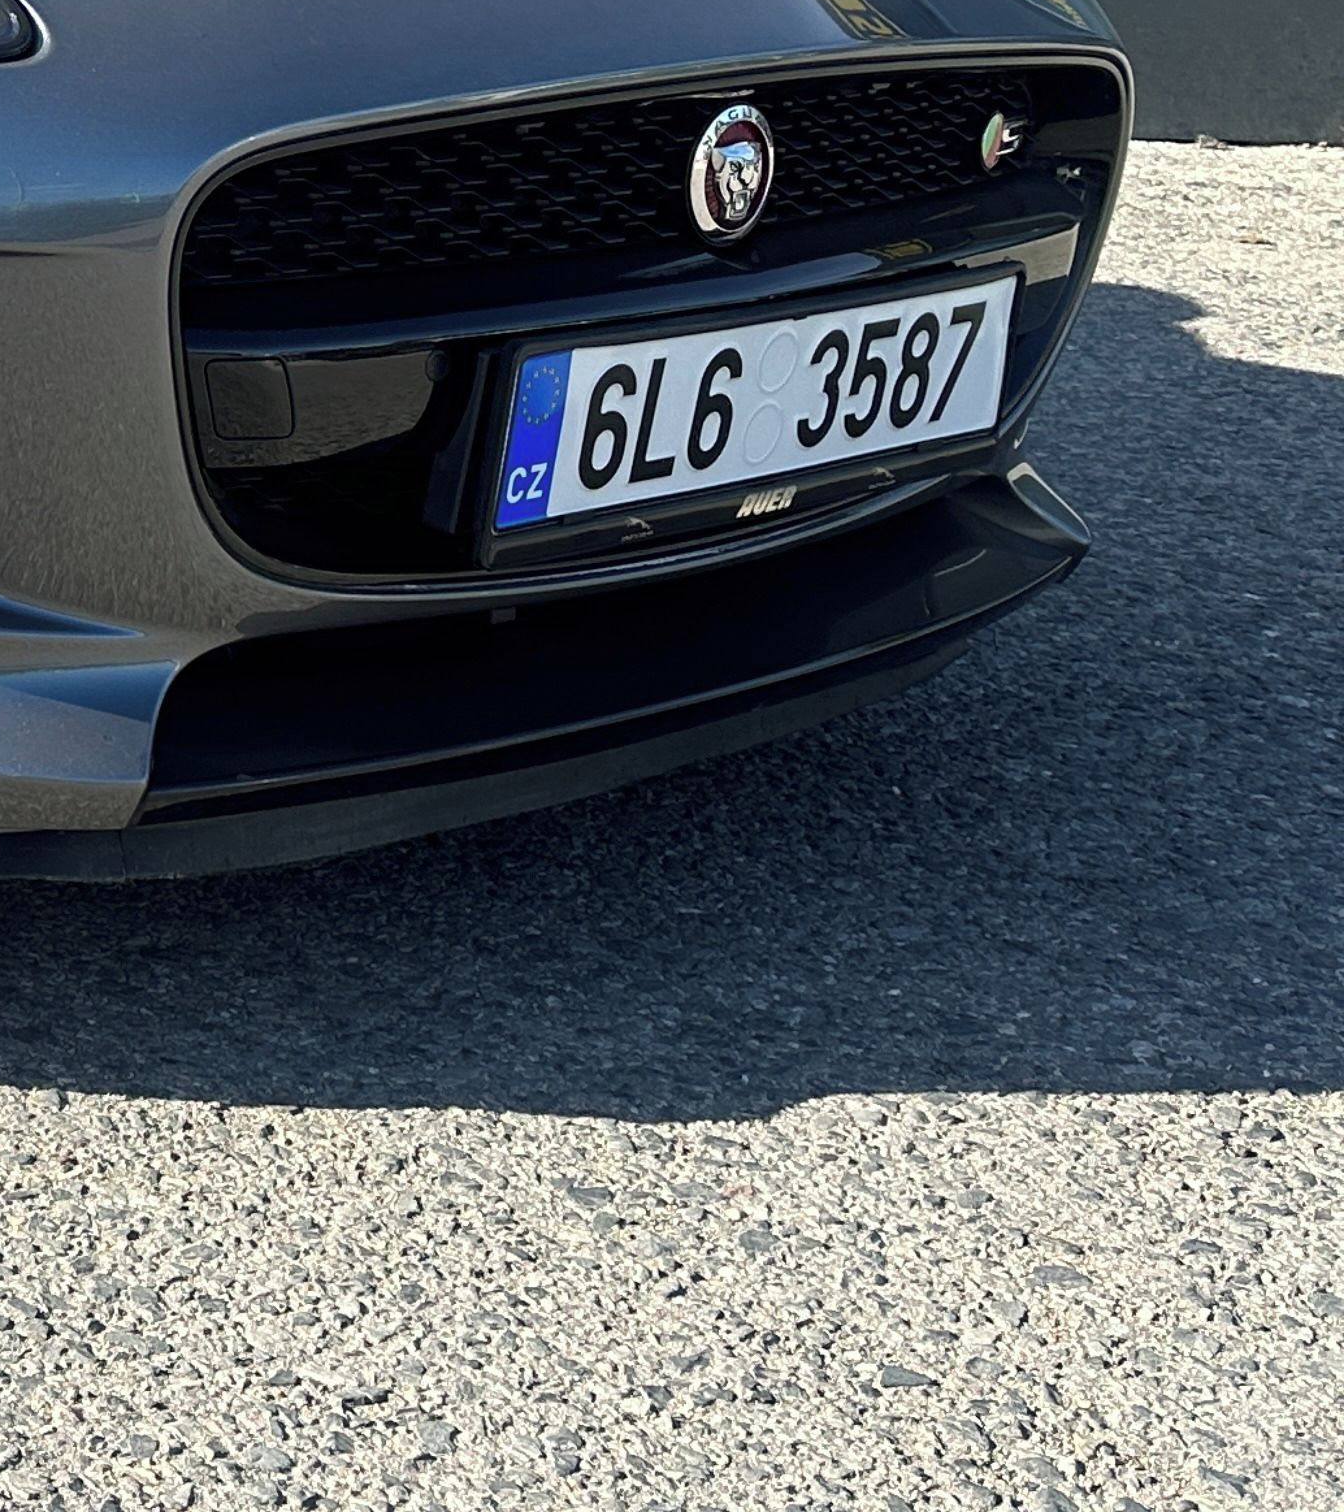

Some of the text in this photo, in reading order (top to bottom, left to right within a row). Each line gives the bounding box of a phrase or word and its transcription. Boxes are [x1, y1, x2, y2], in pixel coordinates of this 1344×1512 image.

[578, 301, 987, 489] 6L6 3587
[506, 462, 548, 504] CZ
